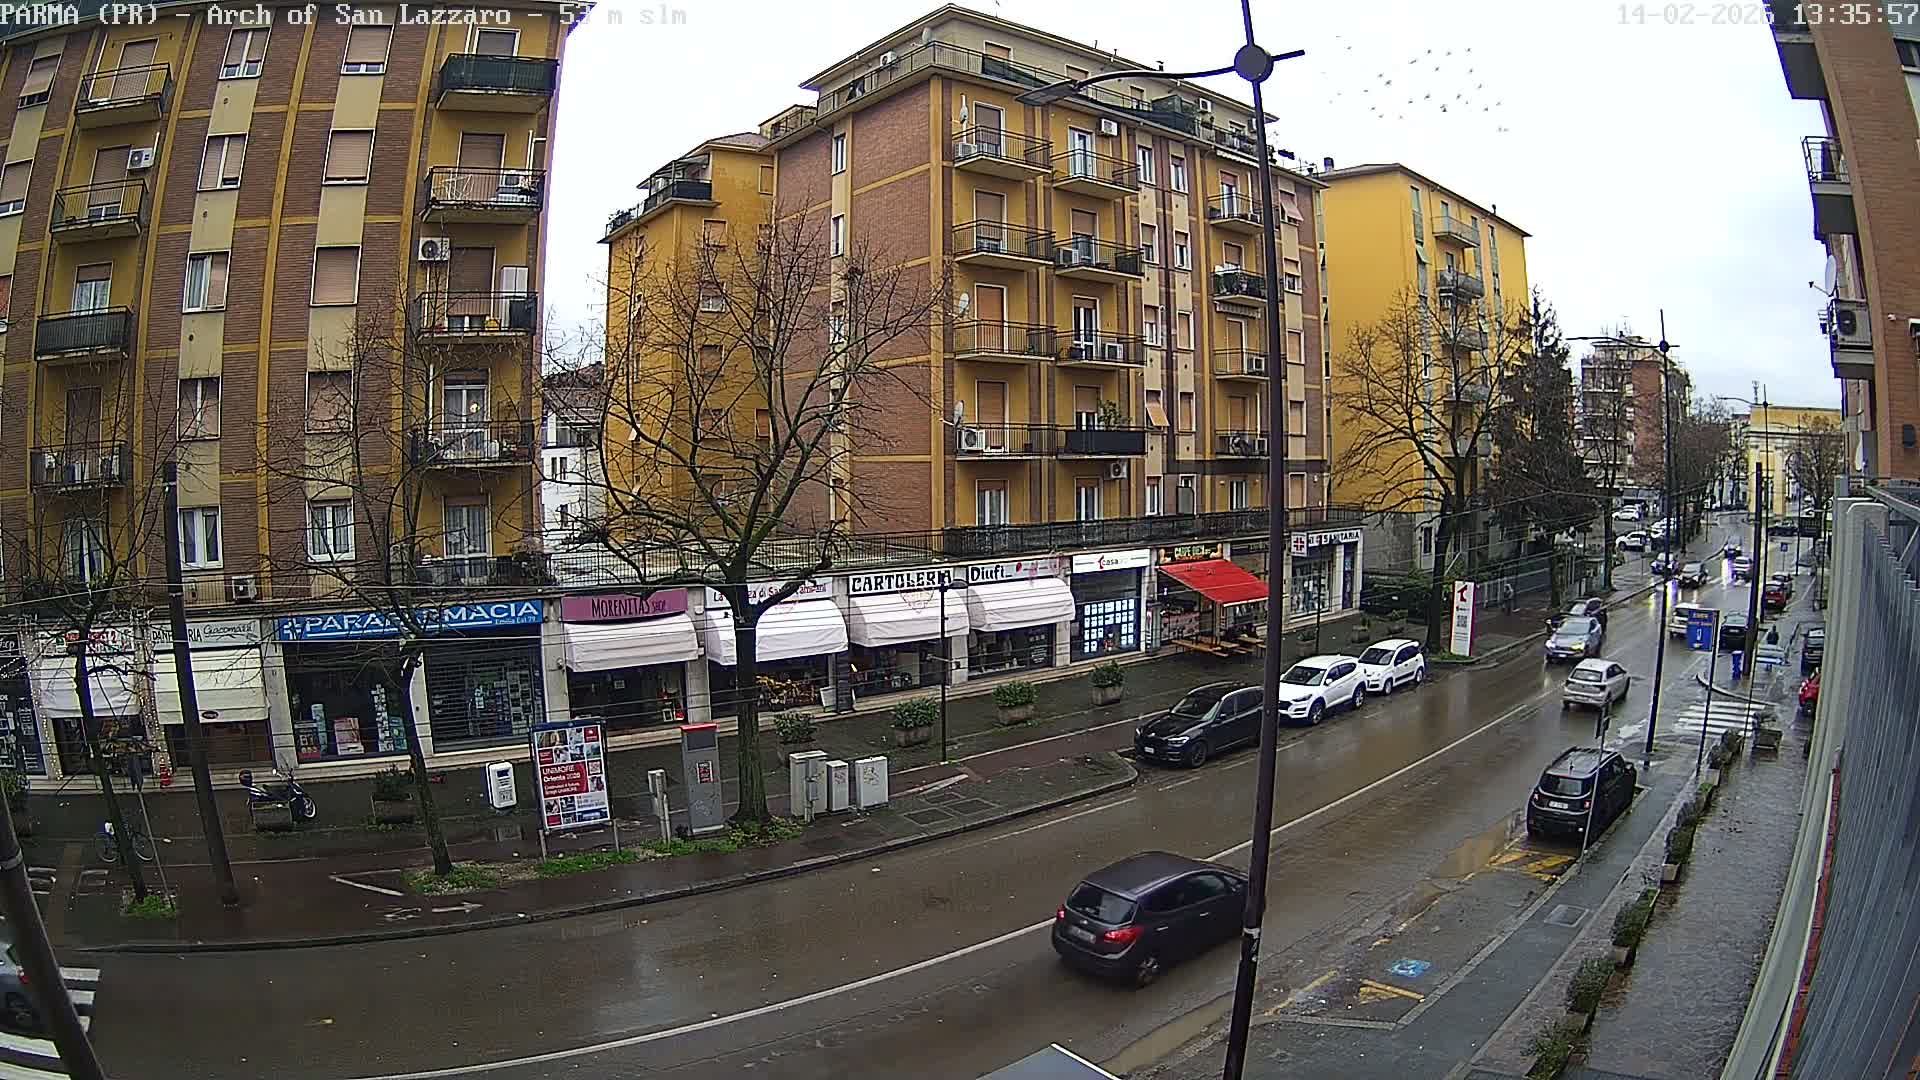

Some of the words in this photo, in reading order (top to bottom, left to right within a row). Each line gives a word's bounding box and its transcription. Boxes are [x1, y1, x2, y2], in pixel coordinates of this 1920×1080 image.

[851, 569, 952, 592] CARTOLERIA
[591, 596, 650, 618] MORENITAS
[713, 591, 724, 602] La
[304, 601, 538, 632] PARAFRMACIA
